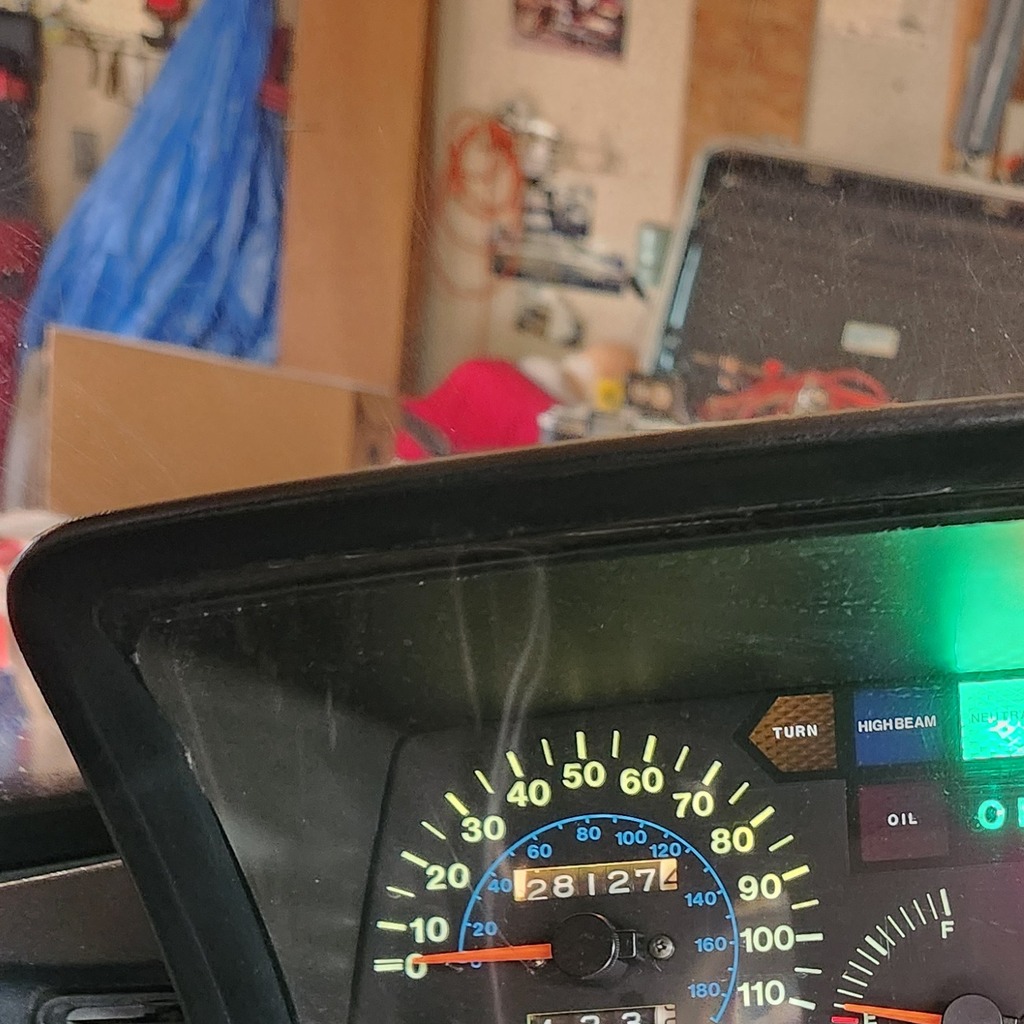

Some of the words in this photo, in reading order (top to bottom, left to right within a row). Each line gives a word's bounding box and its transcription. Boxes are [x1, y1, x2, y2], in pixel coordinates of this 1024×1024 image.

[772, 725, 818, 740] TURN
[562, 762, 606, 788] 50
[619, 766, 664, 795] 60
[506, 778, 551, 808] 40
[673, 790, 714, 818] 70
[461, 815, 507, 841] 30
[887, 812, 918, 827] OIL
[576, 827, 601, 842] 80
[615, 829, 648, 845] 100
[710, 825, 754, 854] 80
[526, 843, 553, 859] 60
[650, 842, 682, 858] 120
[425, 863, 470, 890] 20
[487, 878, 512, 893] 40
[738, 875, 781, 901] 90
[684, 891, 717, 907] 140
[409, 916, 450, 943] 10
[473, 921, 497, 937] 20
[740, 924, 794, 951] 100
[941, 921, 955, 939] F
[694, 937, 727, 953] 160
[688, 983, 721, 999] 180
[737, 979, 785, 1007] 110
